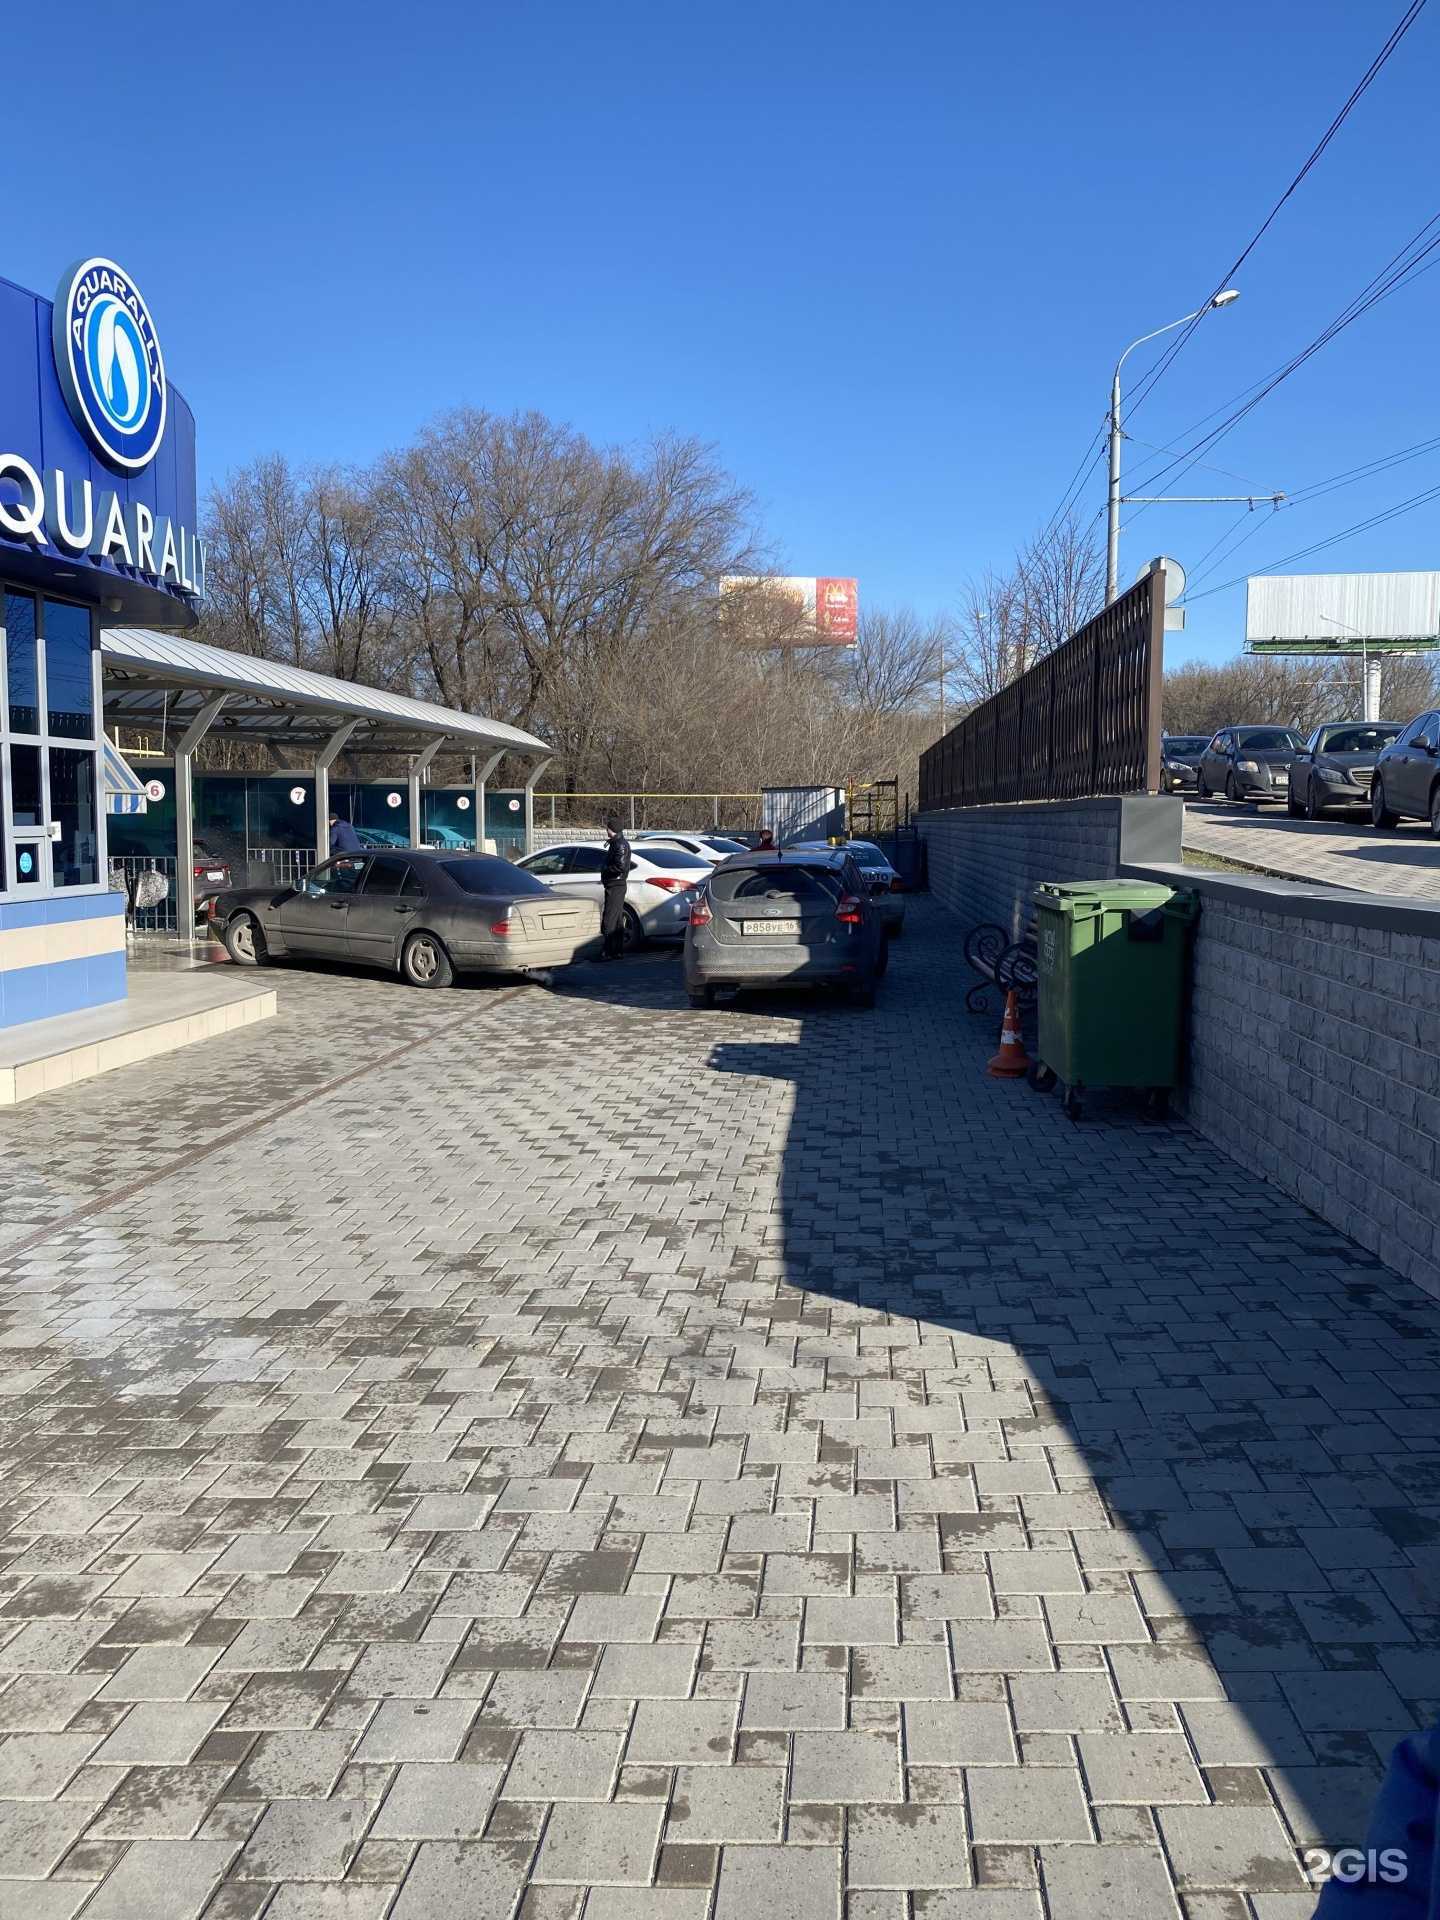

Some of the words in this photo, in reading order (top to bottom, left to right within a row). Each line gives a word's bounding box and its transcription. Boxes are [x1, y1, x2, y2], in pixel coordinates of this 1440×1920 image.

[72, 269, 162, 398] AQUARALLY
[150, 785, 160, 797] 6
[294, 791, 303, 801] 7
